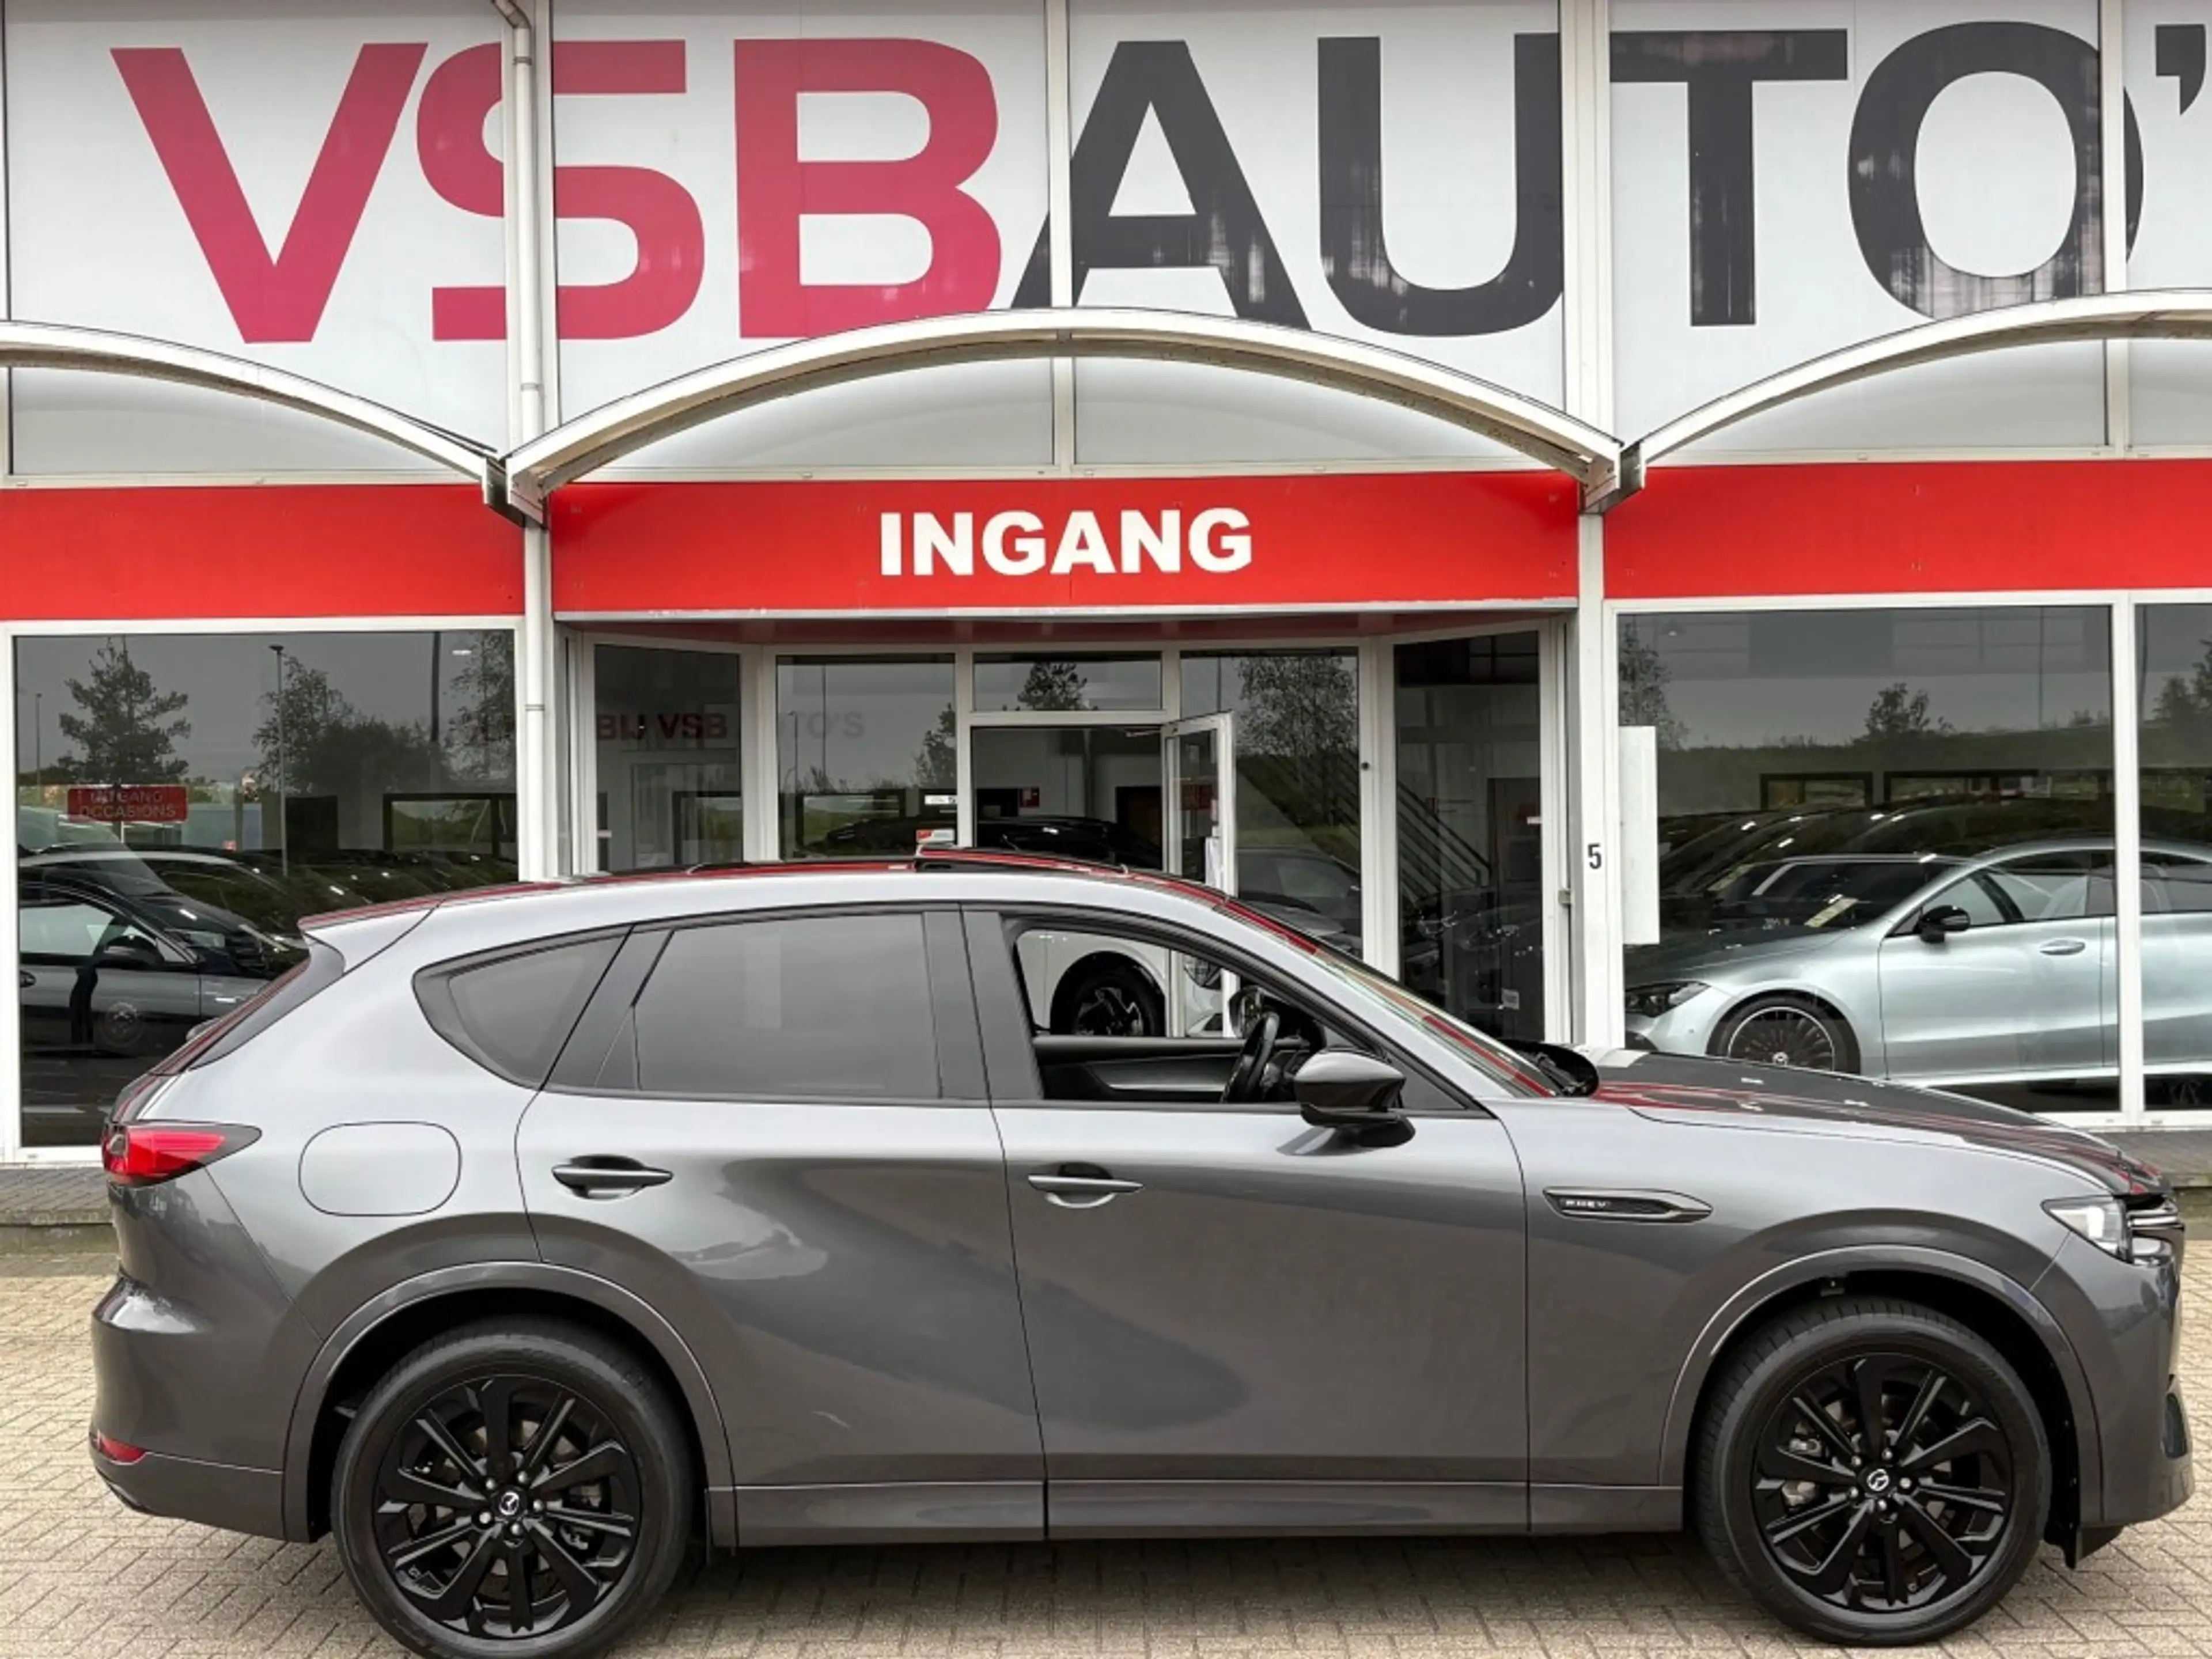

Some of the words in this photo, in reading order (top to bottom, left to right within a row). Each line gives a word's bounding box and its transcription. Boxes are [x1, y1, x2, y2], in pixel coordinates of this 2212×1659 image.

[881, 507, 1251, 575] INGANG
[657, 713, 727, 739] VSB
[79, 804, 176, 818] OCCASIONS
[1588, 843, 1601, 869] 5
